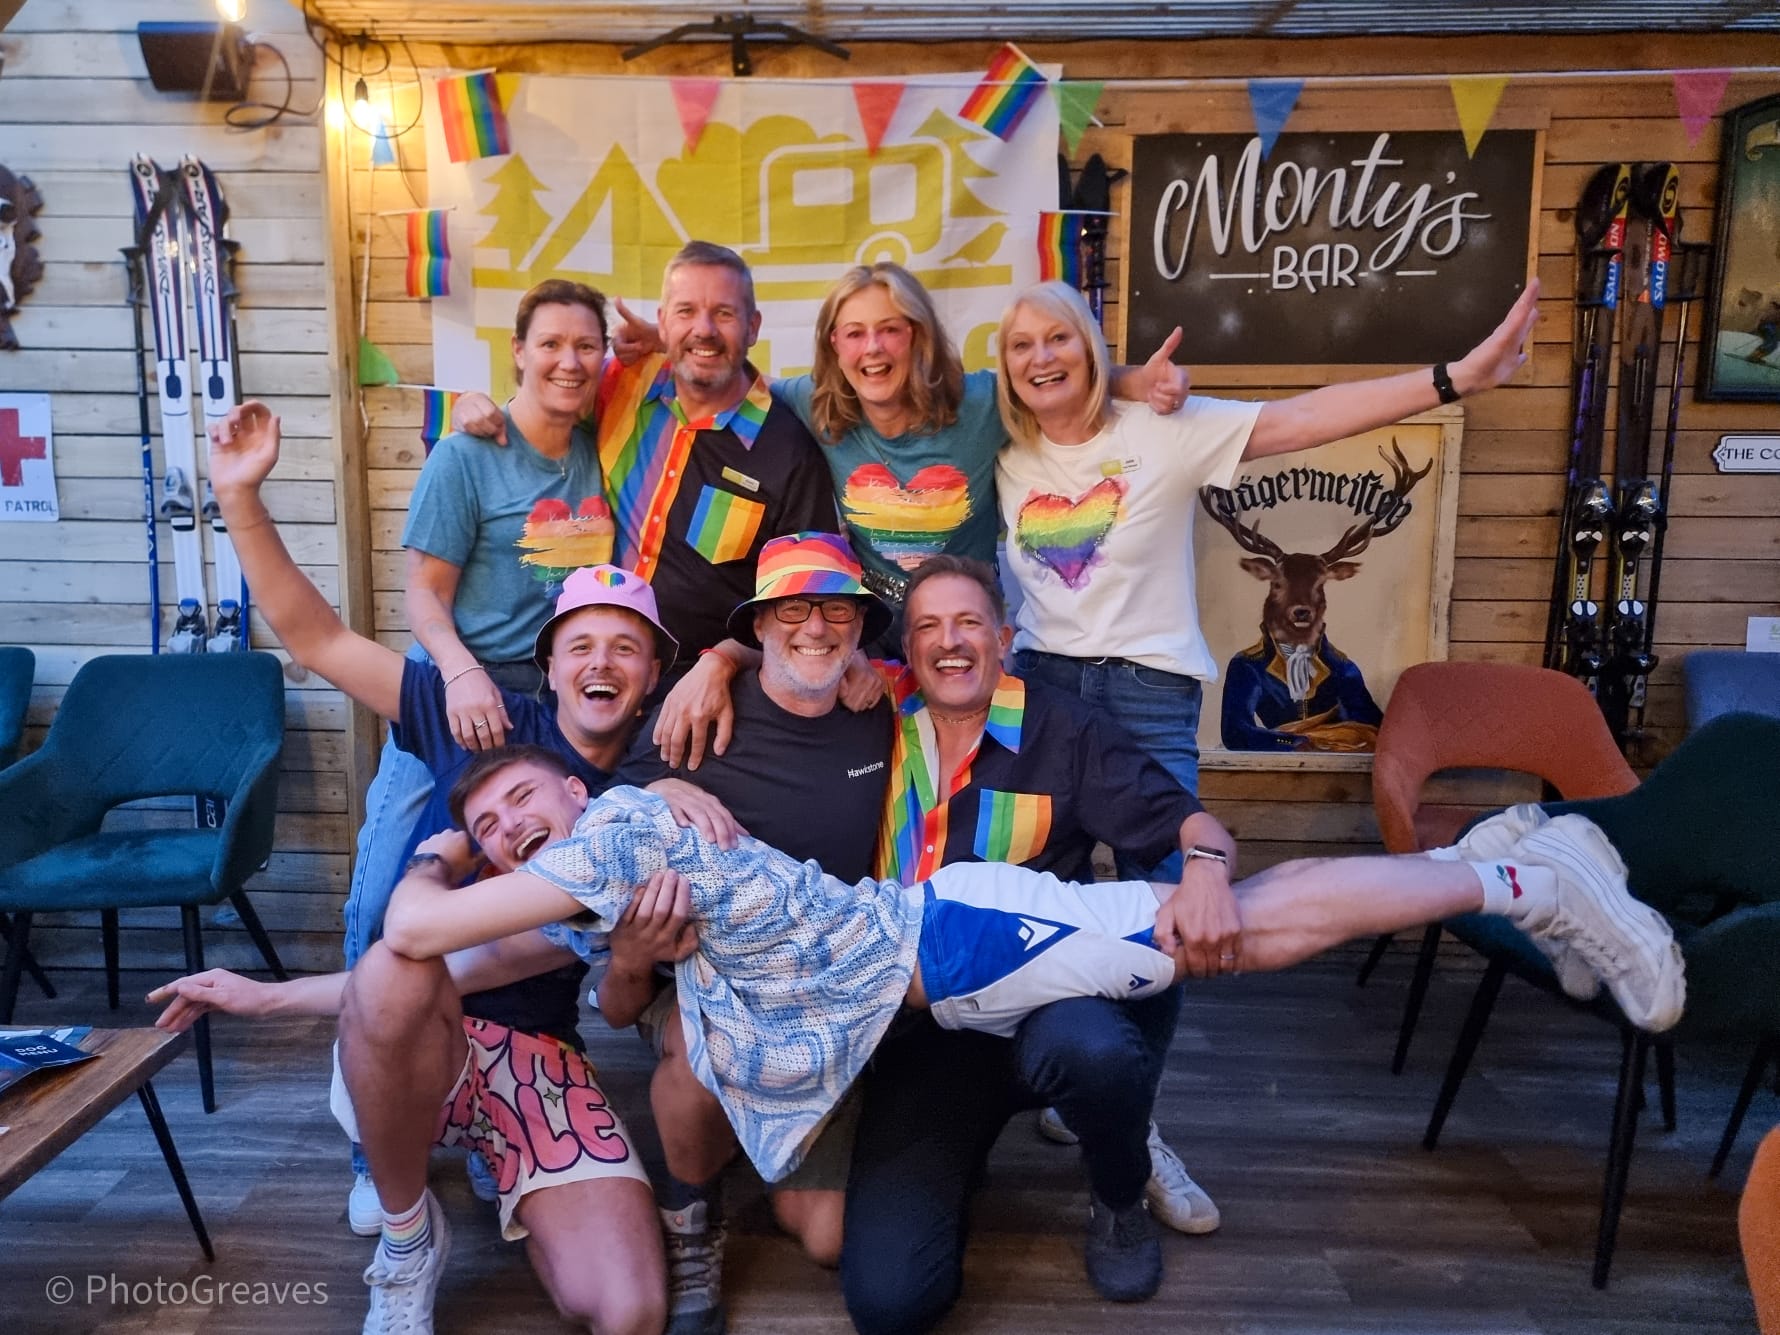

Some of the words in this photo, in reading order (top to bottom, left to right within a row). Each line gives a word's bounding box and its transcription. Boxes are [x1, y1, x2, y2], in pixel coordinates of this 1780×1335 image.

[1153, 132, 1491, 280] Monty's
[1271, 243, 1360, 294] BAR
[1724, 448, 1755, 460] THE
[5, 500, 57, 512] PATROL
[847, 761, 884, 779] Hawkstone
[15, 1045, 47, 1053] DOG
